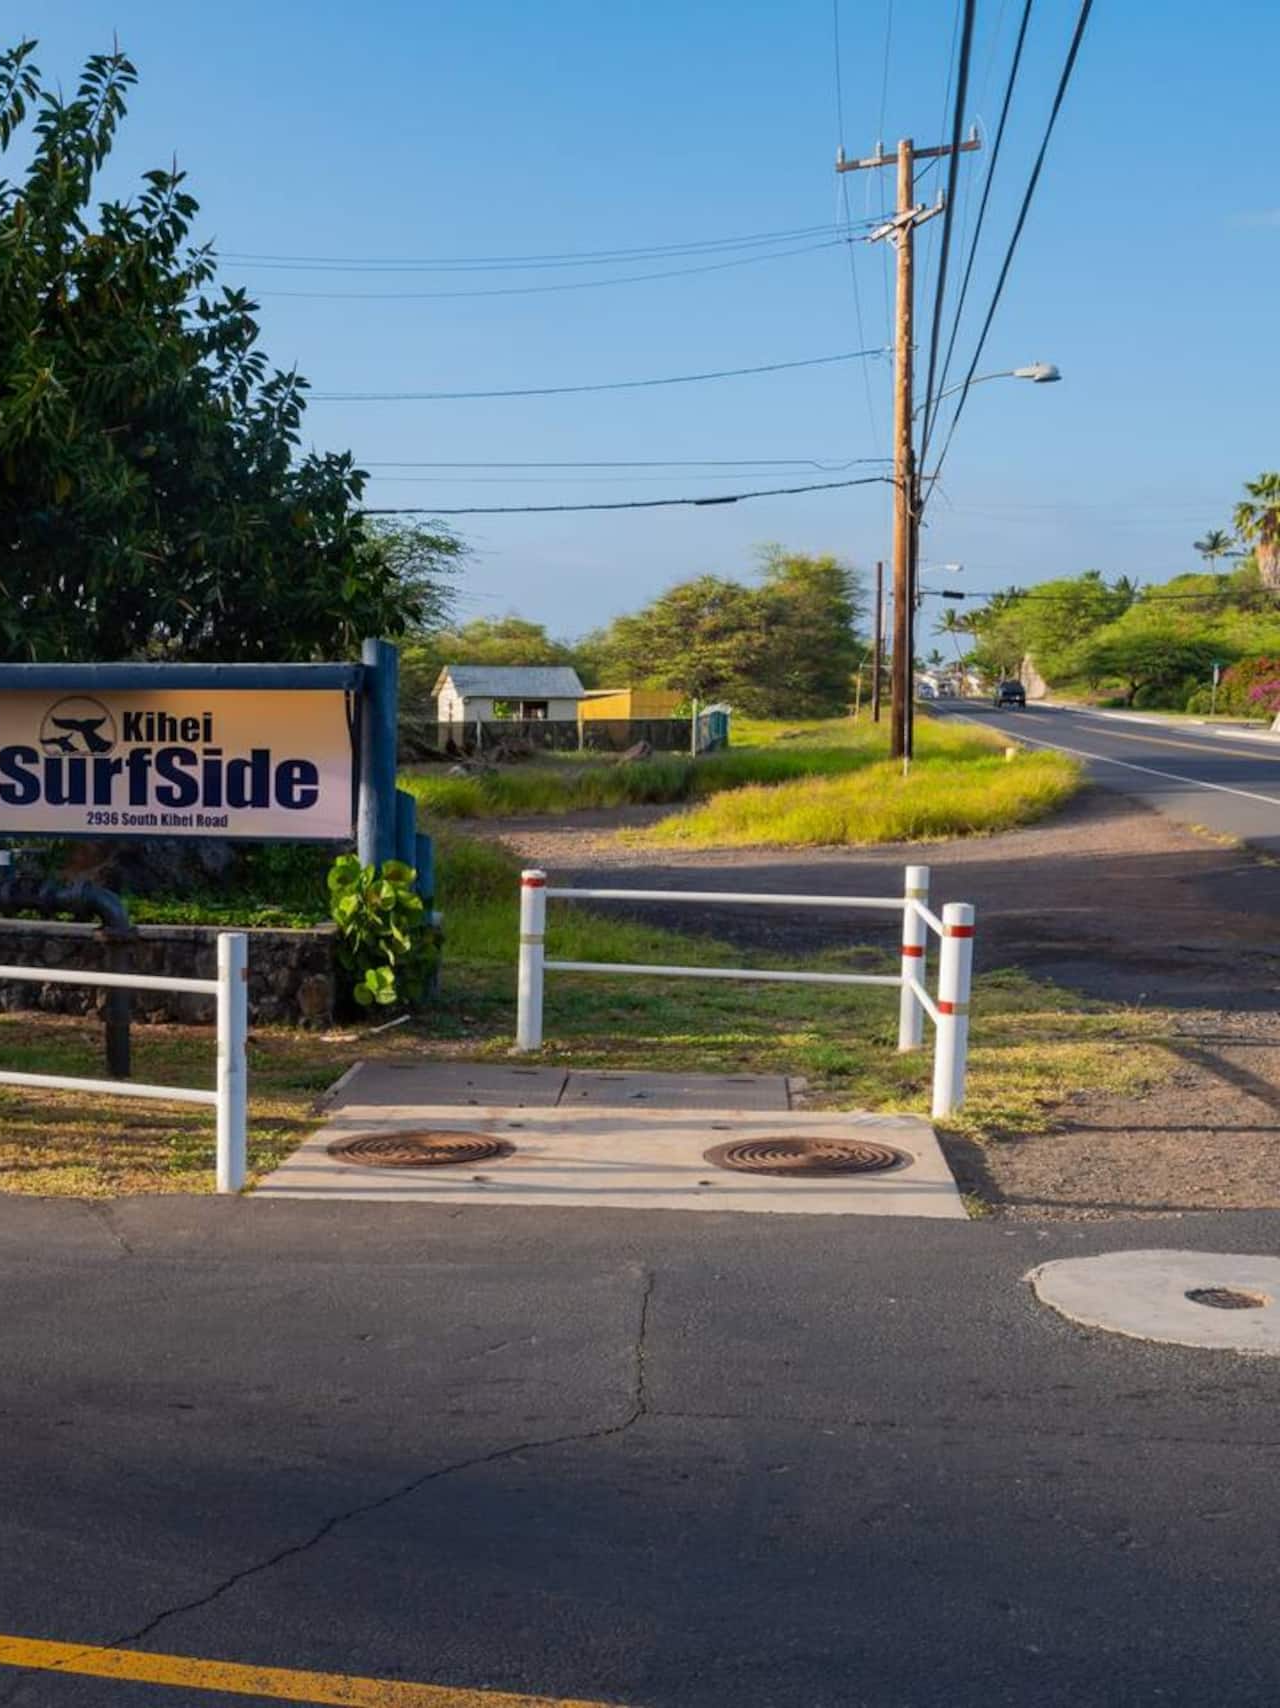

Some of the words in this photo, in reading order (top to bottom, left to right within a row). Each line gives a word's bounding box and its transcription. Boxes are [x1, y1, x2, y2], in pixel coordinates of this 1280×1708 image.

[122, 711, 213, 743] Kihei
[86, 811, 119, 826] 2936
[121, 812, 158, 827] South
[160, 813, 193, 828] Kihei
[196, 813, 228, 829] Road
